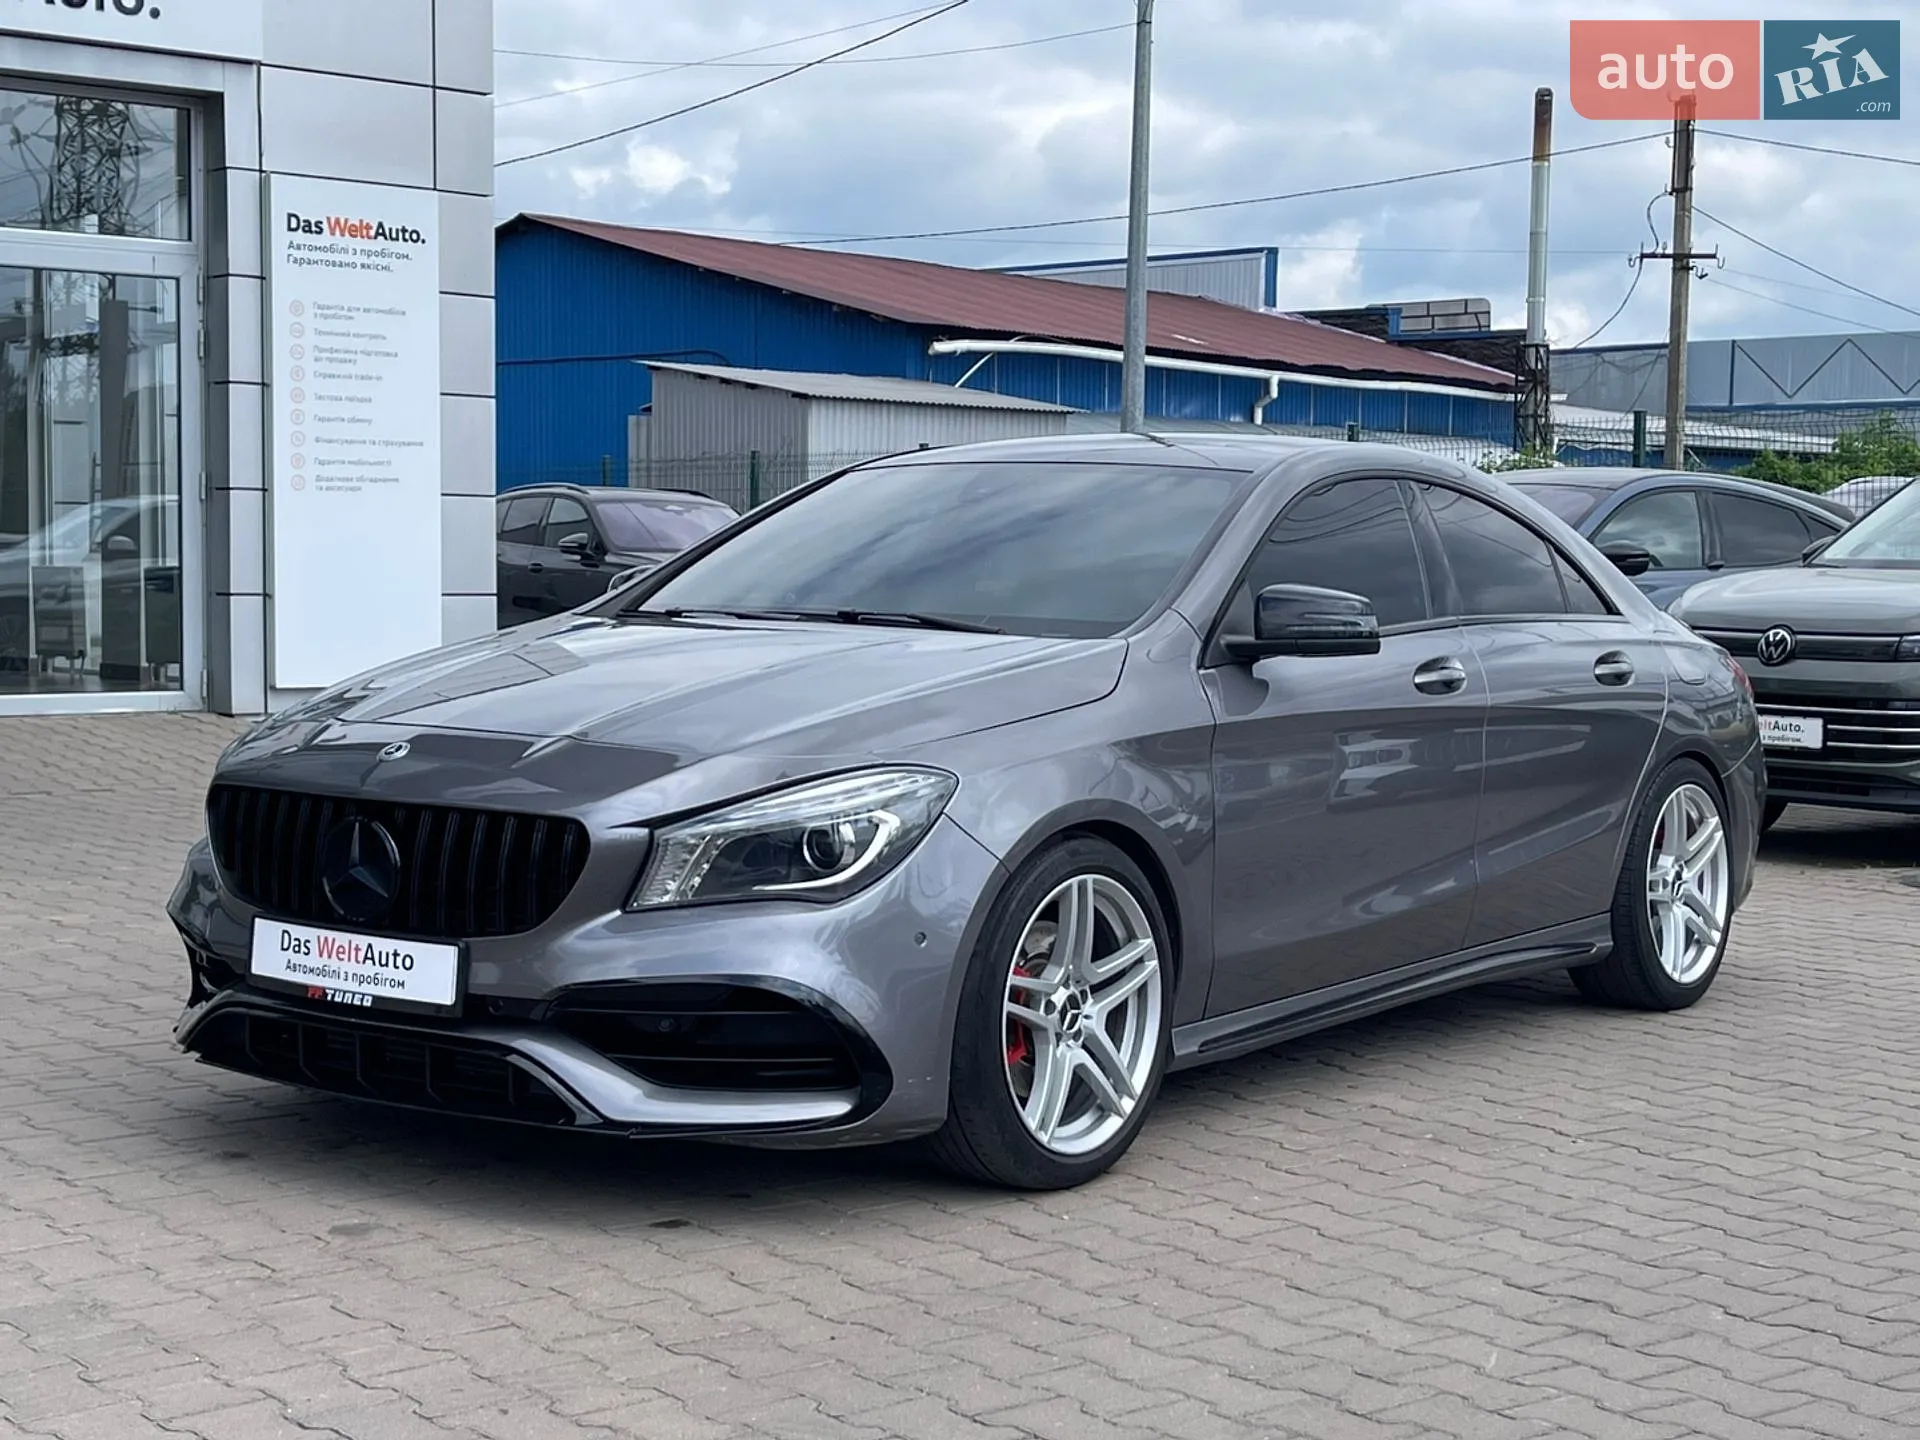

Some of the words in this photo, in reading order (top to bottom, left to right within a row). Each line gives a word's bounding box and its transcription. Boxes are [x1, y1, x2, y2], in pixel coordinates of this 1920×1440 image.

[286, 212, 324, 235] Das
[326, 216, 426, 245] WeltAuto.
[286, 254, 358, 269] Гарантовано
[360, 260, 394, 272] якісні.
[287, 240, 350, 255] Автомобілі
[351, 247, 357, 256] з
[360, 247, 413, 261] пробігом.
[280, 929, 311, 956] Das
[316, 934, 415, 972] WeltAuto
[285, 959, 342, 980] Автомобілі
[343, 970, 349, 981] з
[352, 973, 406, 989] пробігом
